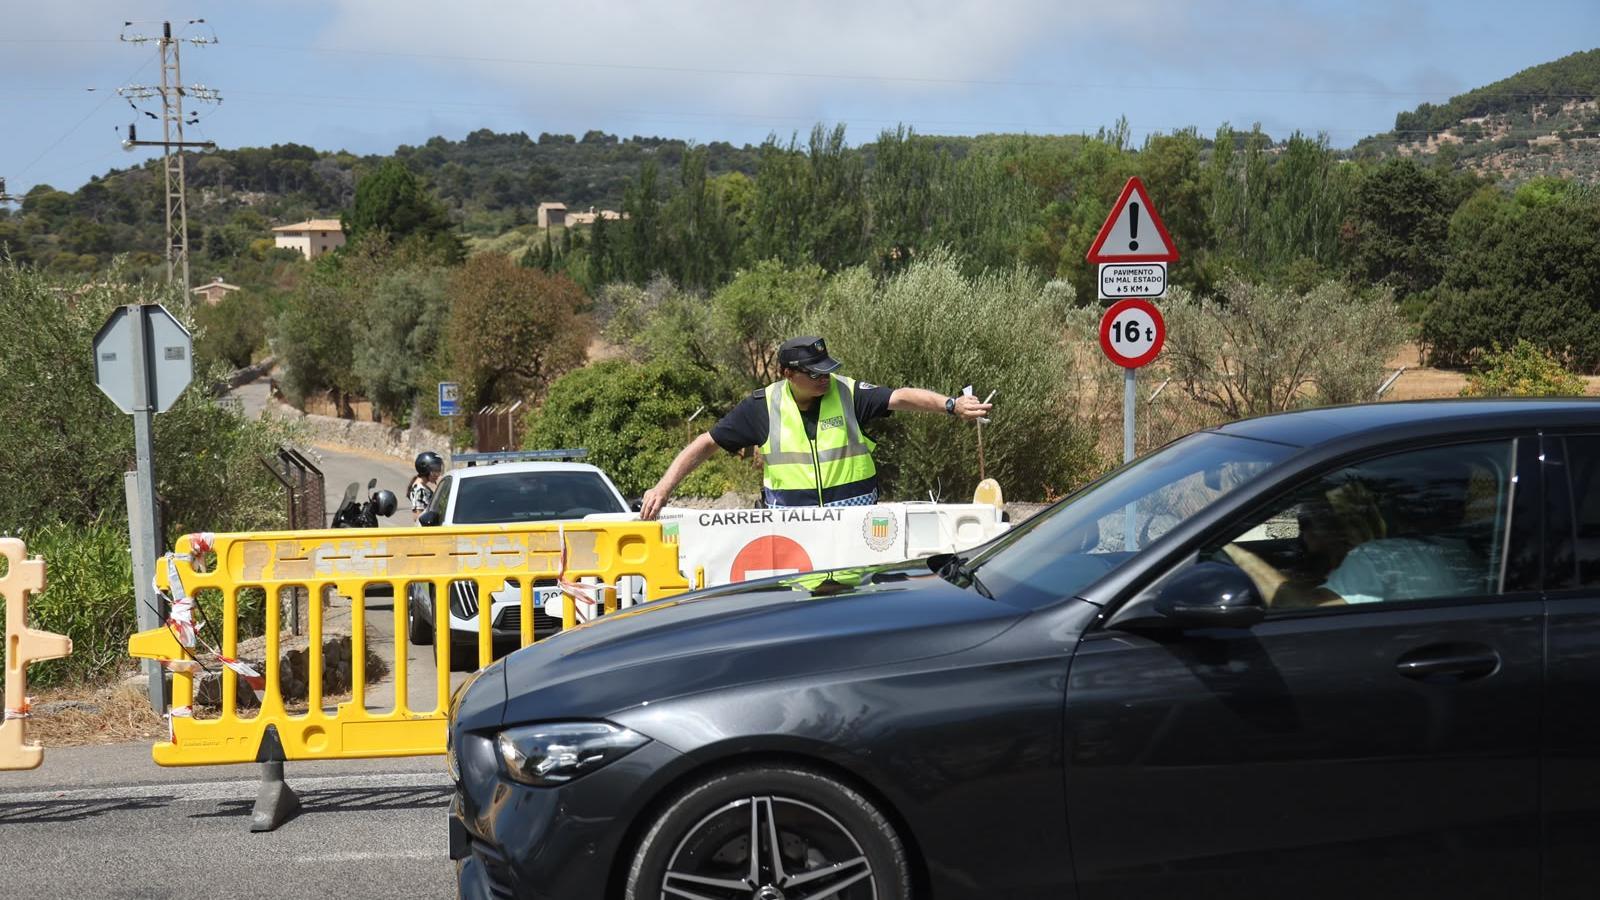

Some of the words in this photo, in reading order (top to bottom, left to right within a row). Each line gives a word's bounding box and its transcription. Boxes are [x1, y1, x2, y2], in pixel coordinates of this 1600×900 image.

[1112, 320, 1140, 342] 16
[1145, 327, 1153, 342] t
[698, 510, 774, 527] CARRER
[779, 508, 844, 522] TALLAT
